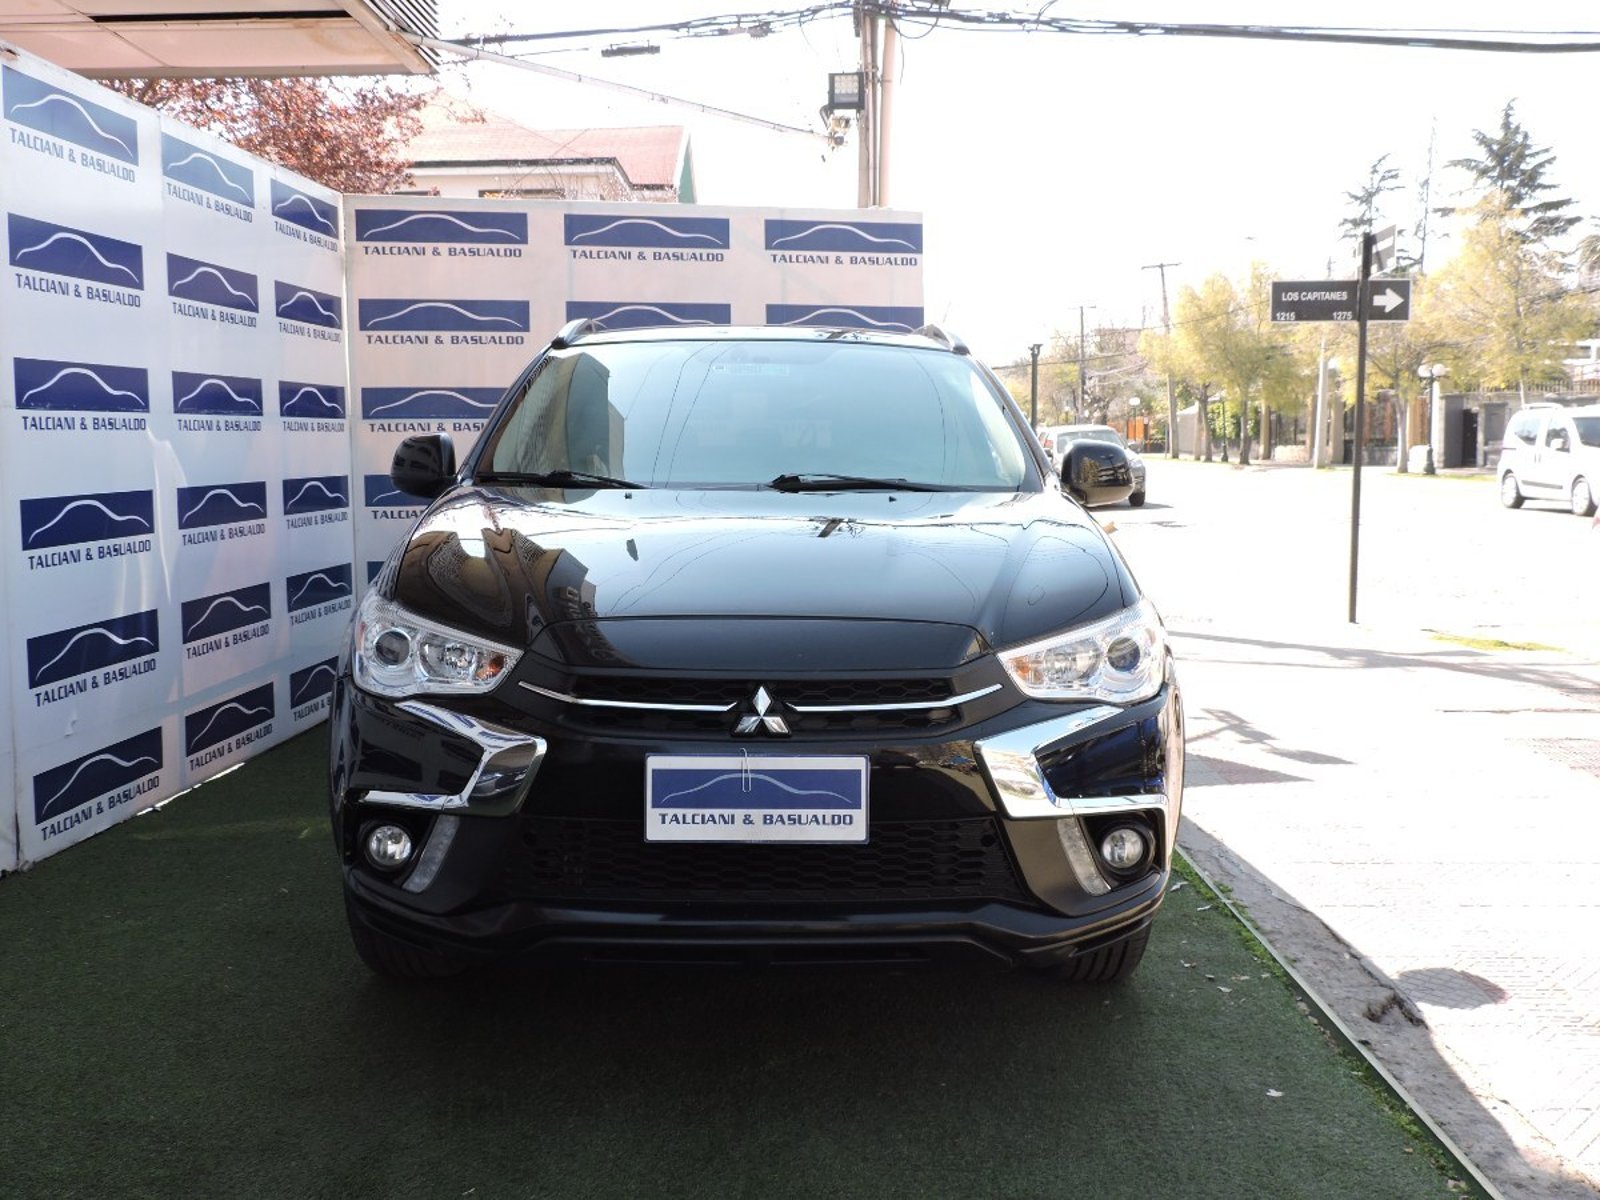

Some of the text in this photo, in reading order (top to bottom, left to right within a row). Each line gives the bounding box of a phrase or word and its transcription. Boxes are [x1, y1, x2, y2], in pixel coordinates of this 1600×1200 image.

[10, 128, 135, 183] TALCIANI & BASUALDO
[166, 182, 253, 223] TALCIANI & BASUALDO
[274, 221, 337, 252] TALCIANI & BASUALDO
[363, 246, 522, 258] TALCIANI & BASUALDO
[571, 250, 724, 262] TALCIANI & BASUALDO
[770, 254, 918, 266] TALCIANI & BASUALDO
[15, 273, 140, 308] TALCIANI & BASUALDO
[1282, 291, 1348, 301] LOS CAPITANES
[172, 302, 257, 328] TALCIANI & BASUALDO
[1276, 312, 1352, 320] 1215 1275
[278, 322, 341, 343] TALCIANI & BASUALDO
[366, 334, 524, 345] TALCIANI & BASUALDO
[22, 416, 146, 431] TALCIANI & BASUALDO
[177, 419, 261, 432] TALCIANI & BASUALDO
[283, 421, 344, 432] TALCIANI & BASUALDO
[369, 423, 430, 432] TALCIANI
[436, 423, 446, 432] &
[286, 512, 348, 530] TALCIANI & BASUALDO
[372, 510, 422, 520] TALCIA
[182, 523, 265, 546] TALCIANI & BASUALDO
[28, 539, 151, 570] TALCIANI & BASUALDO
[186, 624, 269, 660] TALCIANI & BASUALDO
[34, 658, 156, 708] TALCIANI & BASUALDO
[190, 724, 272, 772] TALCIANI & BASUALDO
[41, 775, 159, 841] TALCIANI & BASUALDO
[659, 813, 853, 826] TALCIANI & BASUALDO
